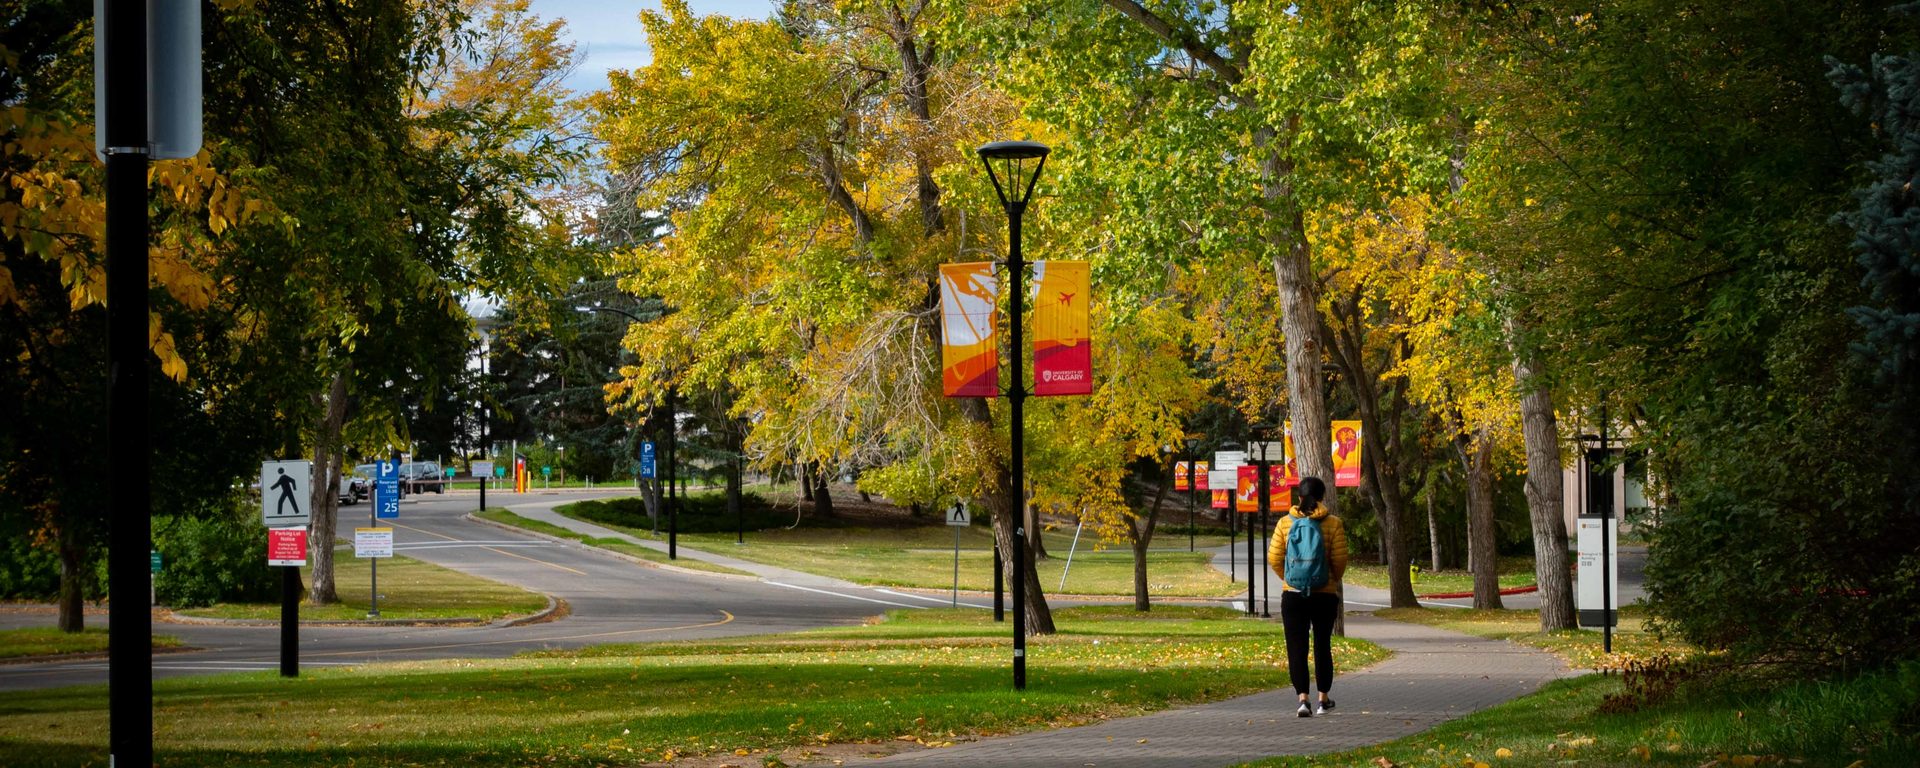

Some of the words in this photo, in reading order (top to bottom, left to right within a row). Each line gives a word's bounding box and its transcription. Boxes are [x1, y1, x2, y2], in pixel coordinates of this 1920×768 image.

[644, 444, 652, 453] P
[381, 462, 393, 477] P
[384, 503, 397, 512] 25
